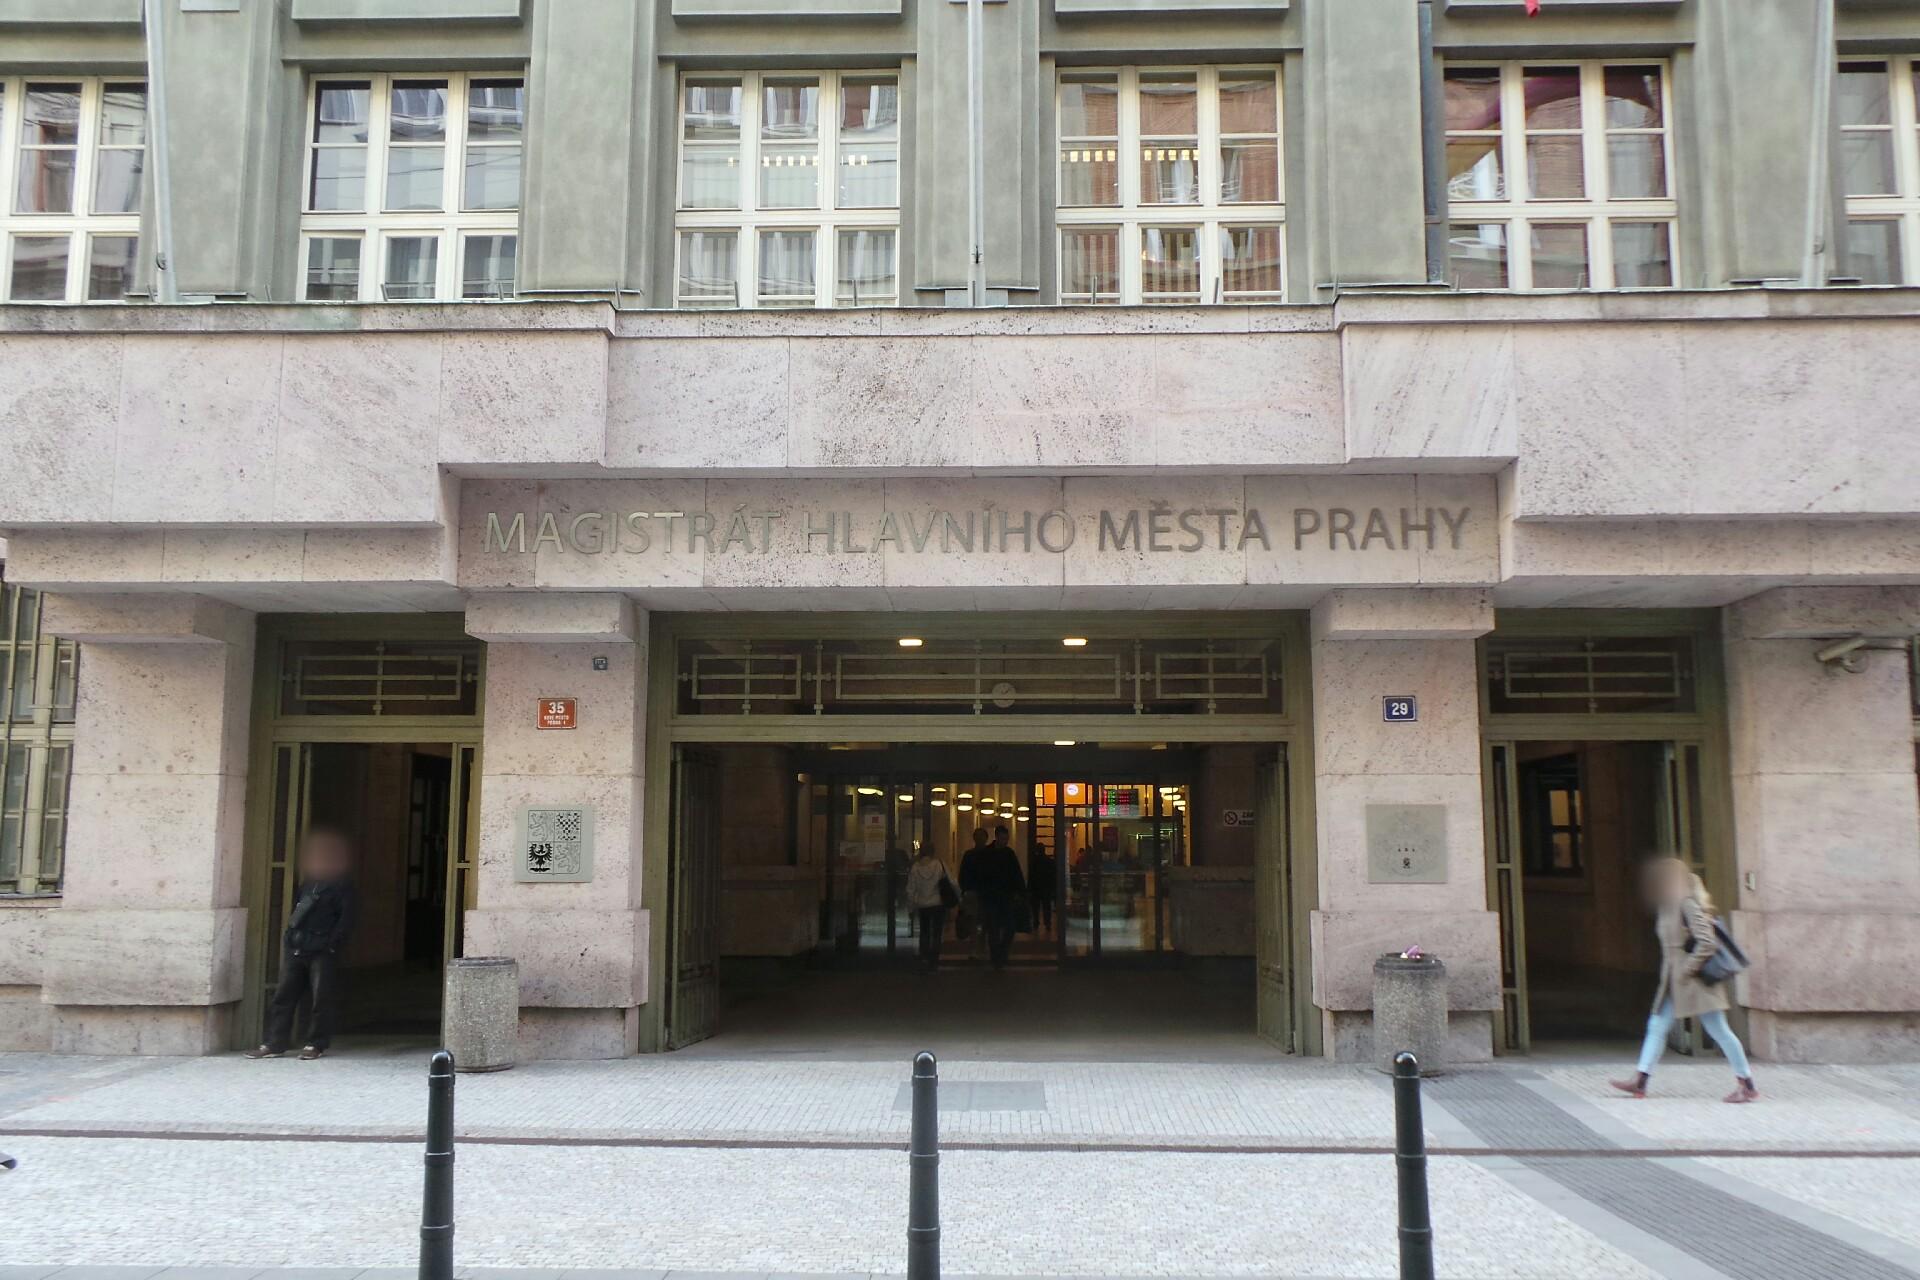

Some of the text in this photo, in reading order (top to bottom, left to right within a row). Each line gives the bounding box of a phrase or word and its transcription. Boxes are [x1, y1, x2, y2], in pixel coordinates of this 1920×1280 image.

[484, 500, 1471, 554] MAGISTRÁT HLAVNÍHO MĚSTA PRAHY
[548, 702, 565, 714] 35
[1391, 702, 1409, 716] 29
